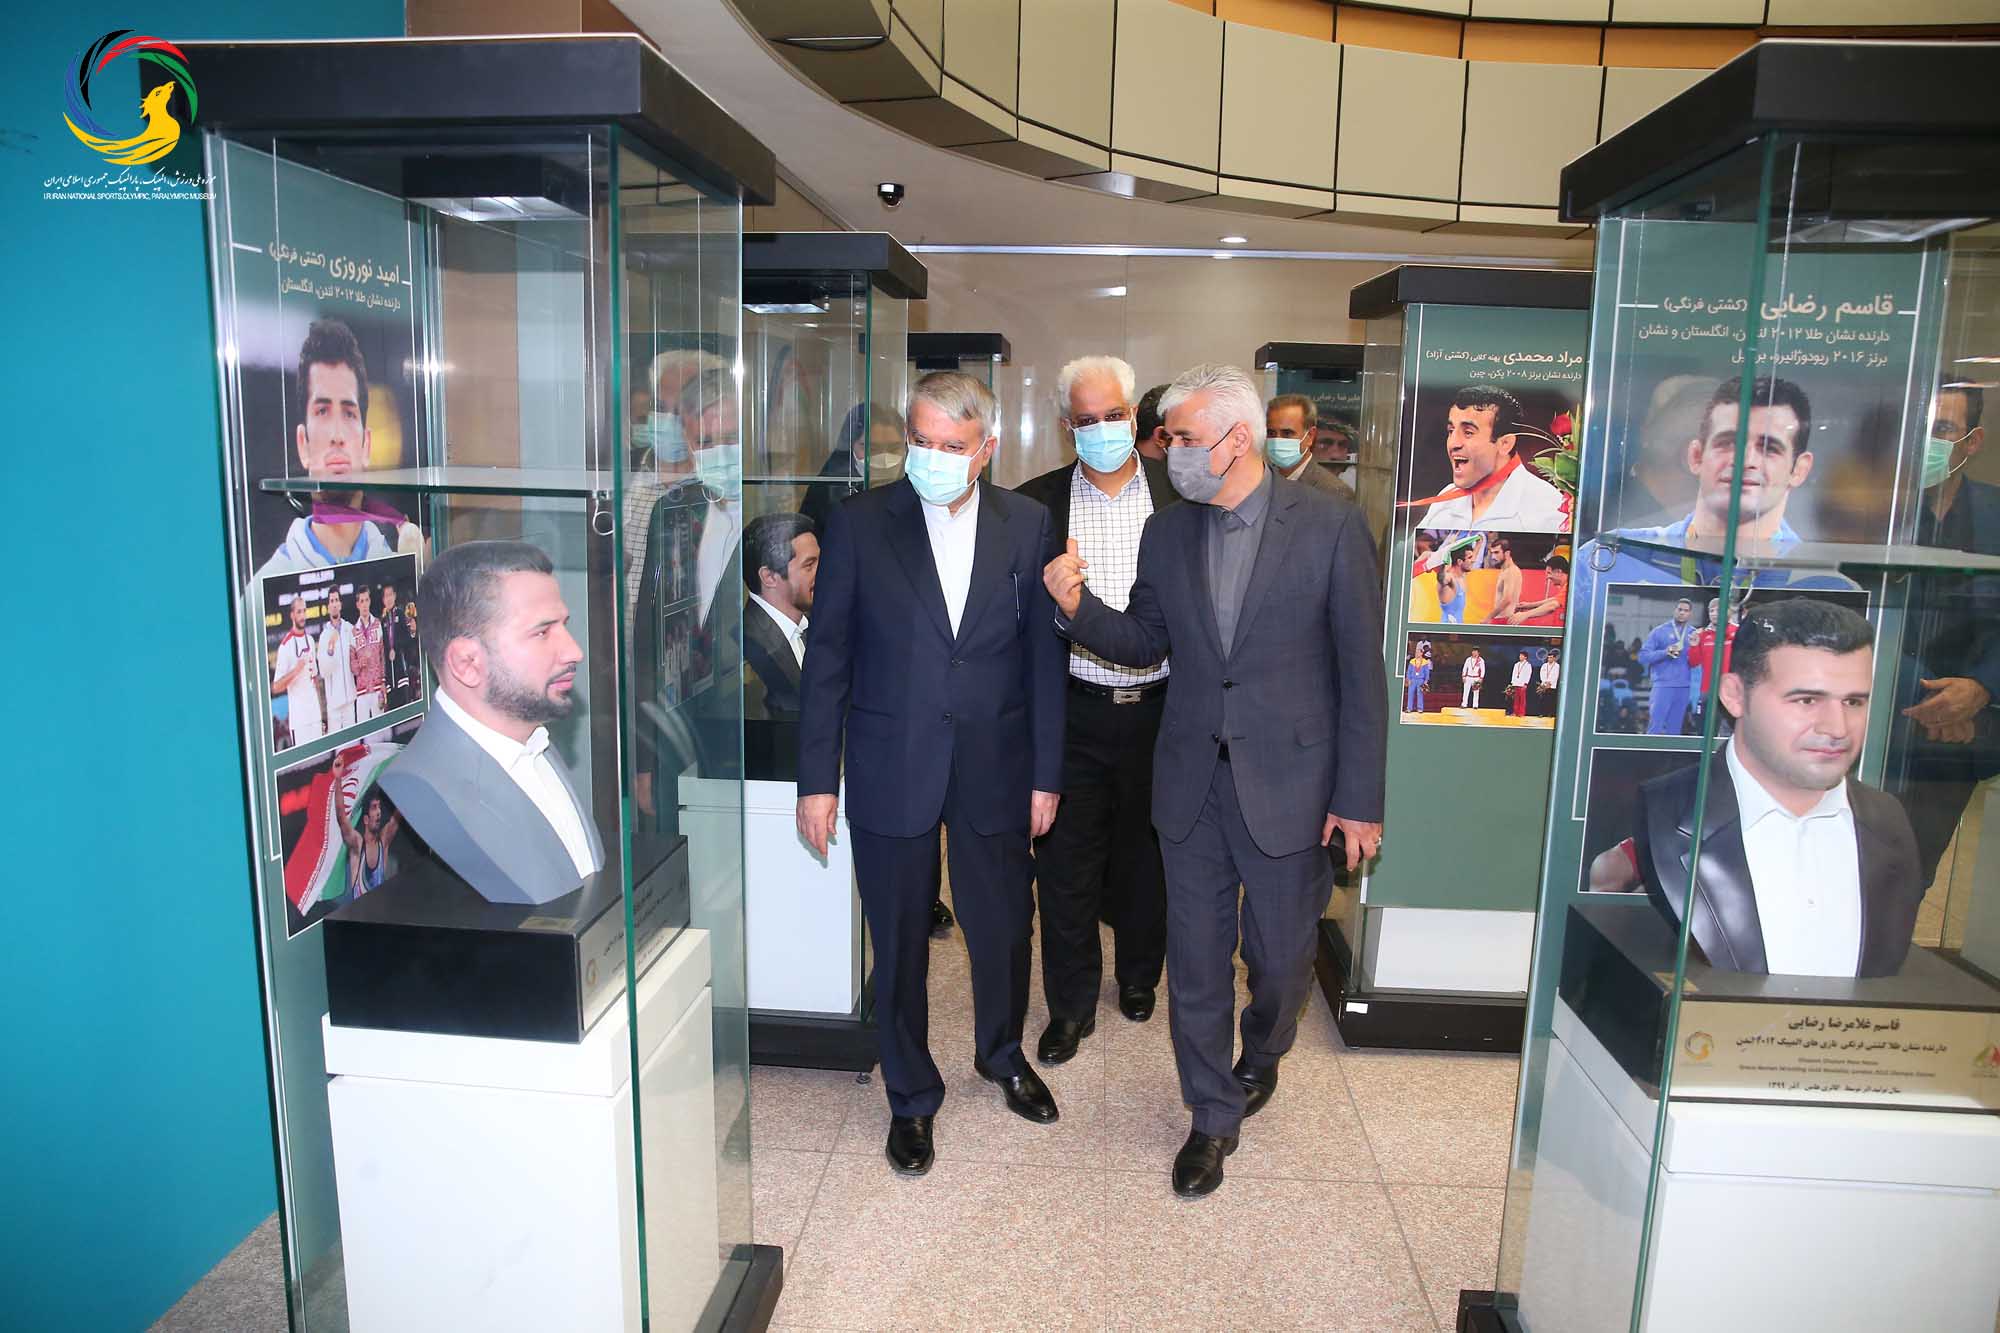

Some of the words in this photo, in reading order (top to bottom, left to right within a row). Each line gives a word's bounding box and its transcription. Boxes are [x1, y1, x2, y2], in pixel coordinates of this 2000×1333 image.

[268, 241, 298, 264] فرنگی)
[300, 251, 326, 268] (کشتی
[330, 256, 373, 283] نوروزی
[377, 264, 400, 287] امید
[281, 277, 314, 294] انگلستان
[336, 286, 354, 301] ۲۰۱۲
[355, 290, 366, 302] طلا
[367, 294, 384, 308] نشان
[384, 298, 401, 312] دارنده
[1663, 296, 1705, 314] فرنگی)
[1708, 297, 1748, 314] (کشتی
[1760, 293, 1827, 321] رضایی
[1835, 293, 1894, 322] قاسم
[1639, 324, 1668, 340] نشان
[1672, 328, 1678, 340] و
[1681, 324, 1728, 340] انگلستان
[1772, 326, 1802, 340] ۲۰۱۲
[1804, 326, 1823, 340] طلا
[1825, 328, 1857, 344] نشان
[1858, 328, 1890, 343] دارنده
[1426, 349, 1442, 360] آزاد)
[1445, 351, 1470, 360] (کشتی
[1504, 352, 1554, 365] محمدی
[1557, 350, 1583, 368] مراد
[1832, 350, 1864, 363] ۲۰۱۶
[1867, 352, 1888, 369] برنز
[1470, 370, 1486, 378] چین
[1506, 369, 1527, 377] ۲۰۰۸
[1528, 371, 1542, 380] برنز
[1542, 371, 1560, 380] نشان
[1561, 372, 1582, 382] دارنده
[1788, 1016, 1824, 1031] رضایی
[1828, 1016, 1871, 1032] غلامرضا
[1873, 1018, 1900, 1032] قاسم
